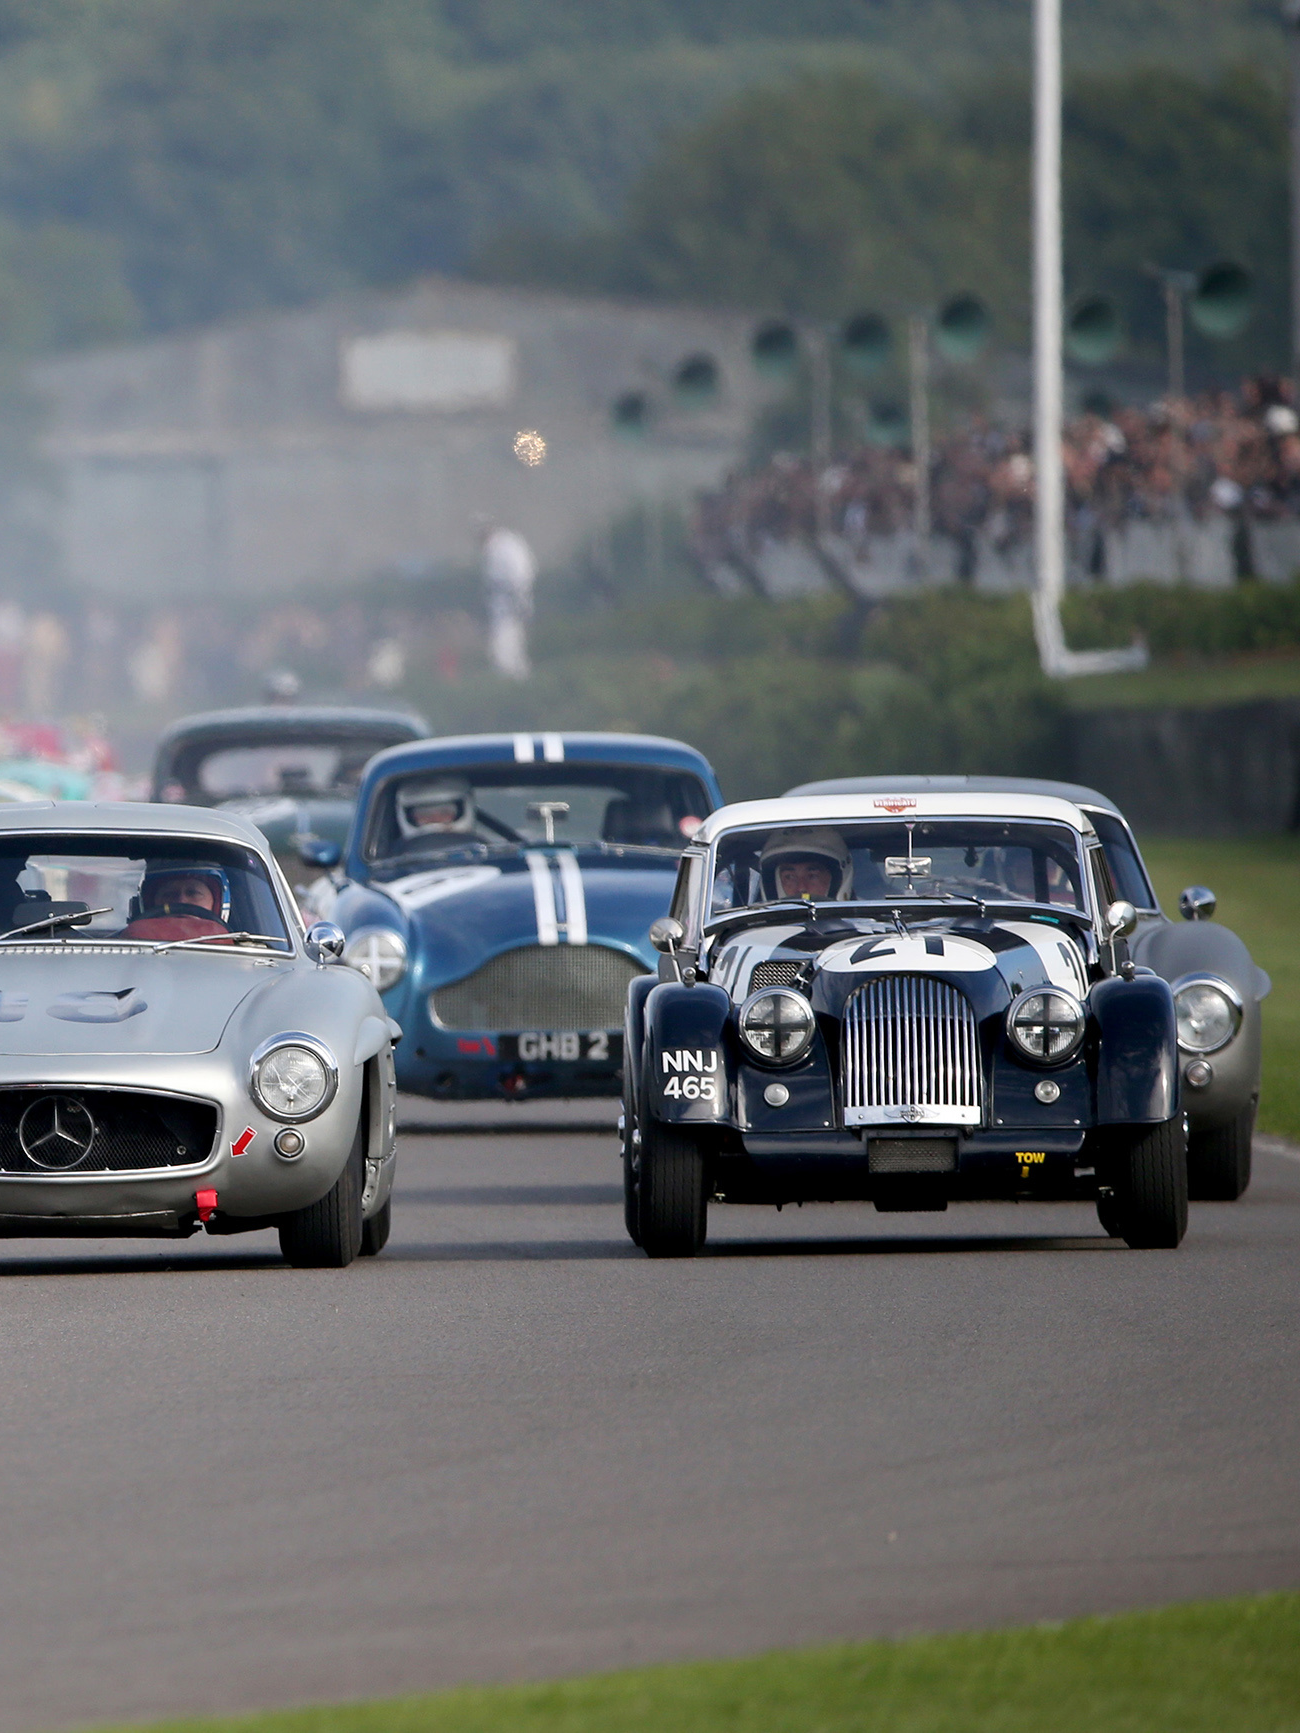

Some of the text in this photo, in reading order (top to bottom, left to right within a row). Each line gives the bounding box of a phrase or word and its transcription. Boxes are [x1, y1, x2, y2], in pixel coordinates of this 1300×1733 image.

[844, 936, 945, 965] 21
[586, 1031, 610, 1061] 2
[662, 1050, 718, 1073] NNJ
[663, 1075, 716, 1100] 465
[1015, 1152, 1046, 1164] TOW
